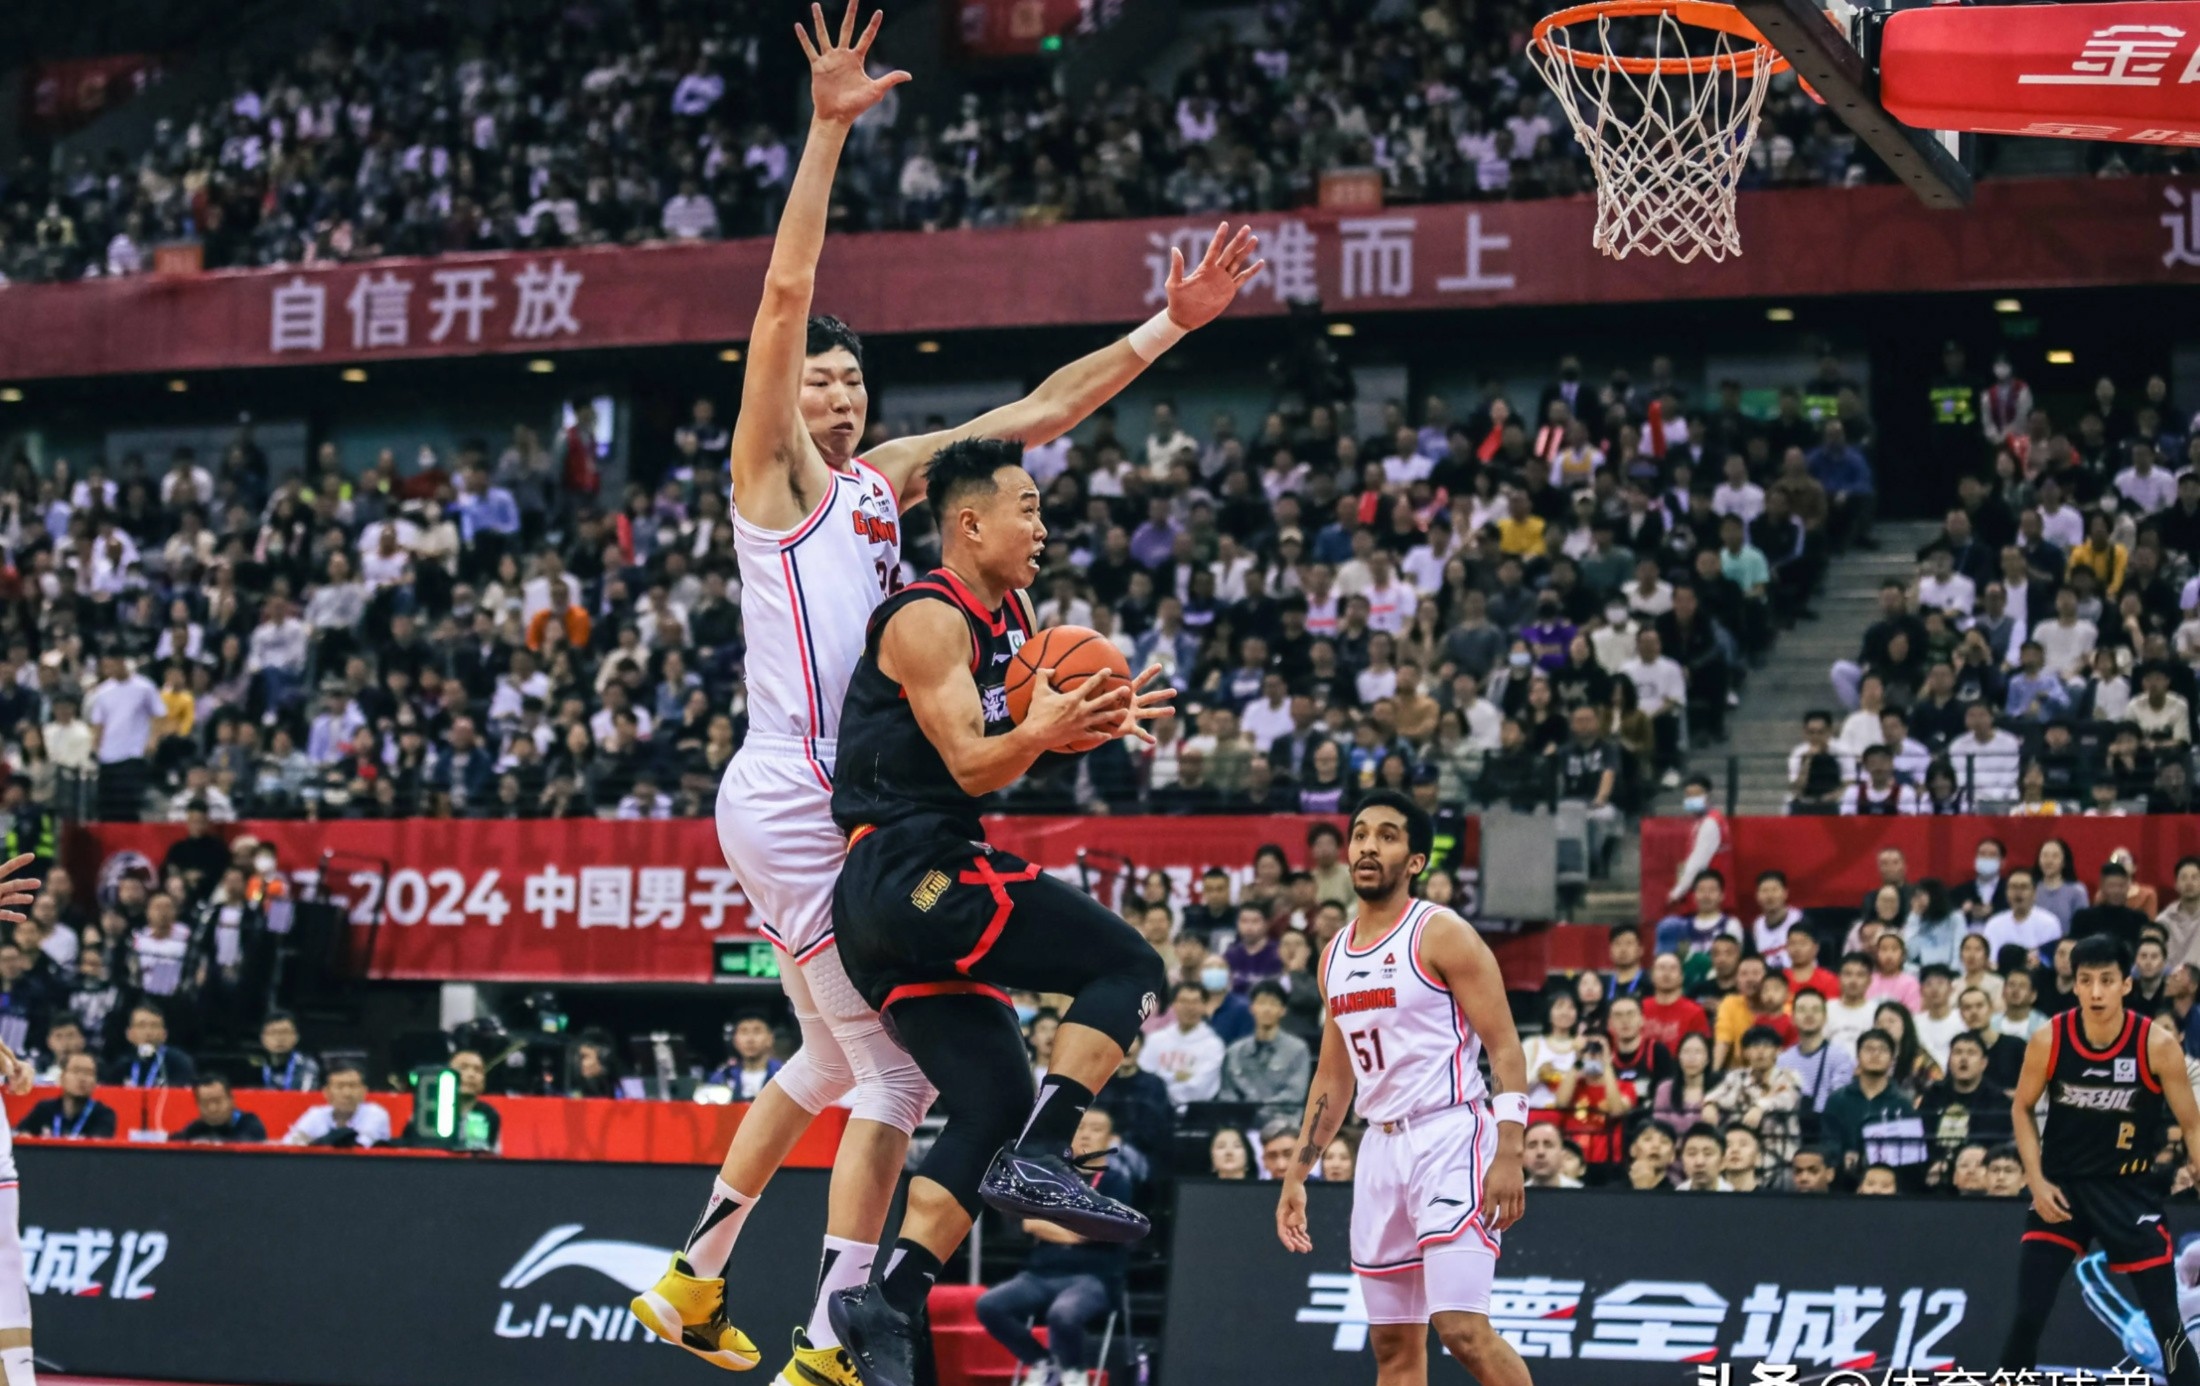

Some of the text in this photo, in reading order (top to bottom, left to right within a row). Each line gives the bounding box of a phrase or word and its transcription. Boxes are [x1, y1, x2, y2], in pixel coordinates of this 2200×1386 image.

[2018, 25, 2200, 86] 金
[270, 260, 585, 353] 自信开放
[524, 864, 762, 930] 中国男子
[1350, 1027, 1385, 1074] 51
[2116, 1121, 2136, 1151] 2
[495, 1301, 672, 1344] LI-NIN
